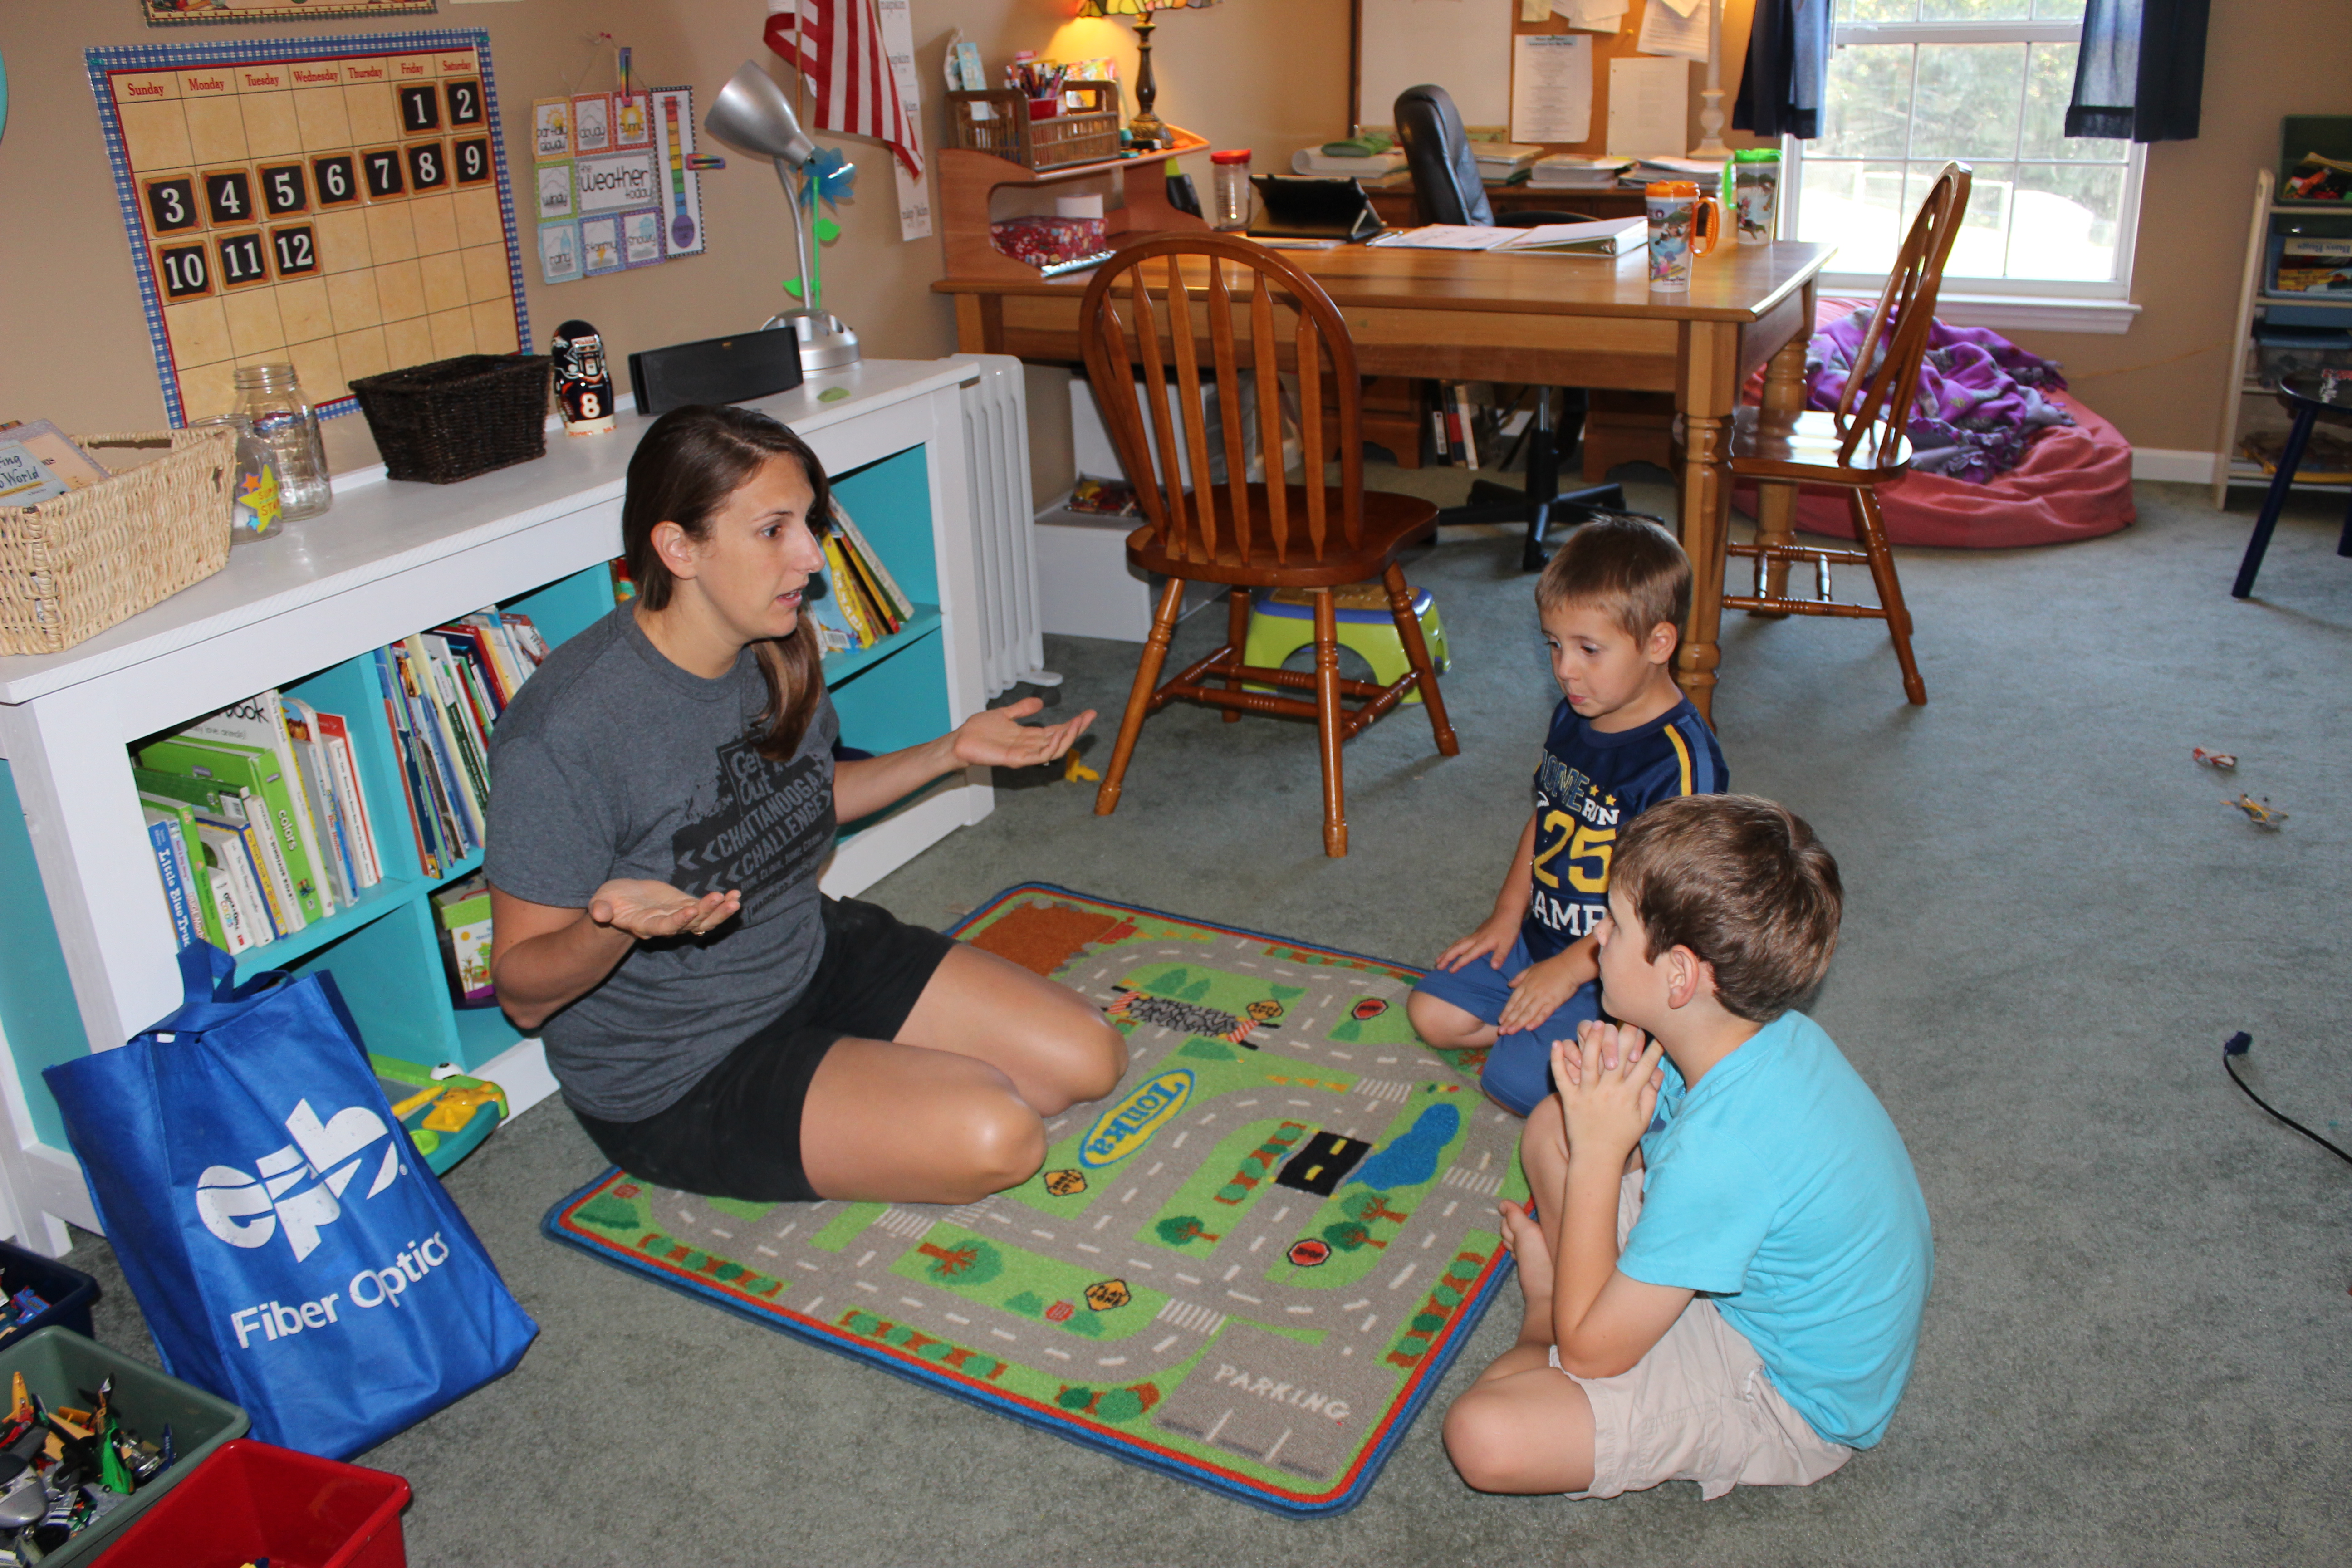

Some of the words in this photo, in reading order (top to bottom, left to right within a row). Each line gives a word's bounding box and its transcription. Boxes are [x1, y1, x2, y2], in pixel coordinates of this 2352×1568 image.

[127, 82, 165, 97] Sunday
[189, 76, 225, 92] Monday
[245, 73, 280, 88] Tuesday
[293, 68, 339, 83] Wednesday
[347, 65, 384, 79] Thursday
[400, 62, 425, 75] Friday
[442, 59, 472, 72] Saturday
[412, 94, 428, 125] 1
[456, 88, 474, 120] 2
[579, 126, 606, 139] cloudy
[161, 188, 185, 224] 3
[220, 181, 240, 214] 4
[275, 173, 295, 207] 5
[326, 165, 347, 196] 6
[374, 159, 390, 189] 7
[420, 152, 437, 182] 8
[464, 145, 481, 175] 9
[580, 165, 649, 192] weather
[625, 186, 653, 200] today
[542, 193, 568, 207] windy
[164, 253, 204, 289] 10
[224, 241, 261, 277] 11
[277, 234, 313, 269] 12
[580, 392, 601, 419] 8
[0, 455, 22, 468] ing
[0, 466, 40, 487] World
[731, 749, 766, 779] Get
[739, 771, 774, 806] Out
[277, 808, 299, 852] colors
[717, 769, 823, 858] CHATTANOOGA
[741, 794, 826, 876] CHALLENGE
[1533, 809, 1617, 893] 25
[157, 848, 178, 887] Little
[270, 841, 285, 877] DINOSAUR
[168, 887, 186, 917] Blue
[175, 915, 193, 947] Truc
[1089, 1081, 1186, 1156] Tonka
[230, 1293, 339, 1349] Fiber
[349, 1231, 450, 1308] Optics
[1214, 1363, 1351, 1420] PARKING
